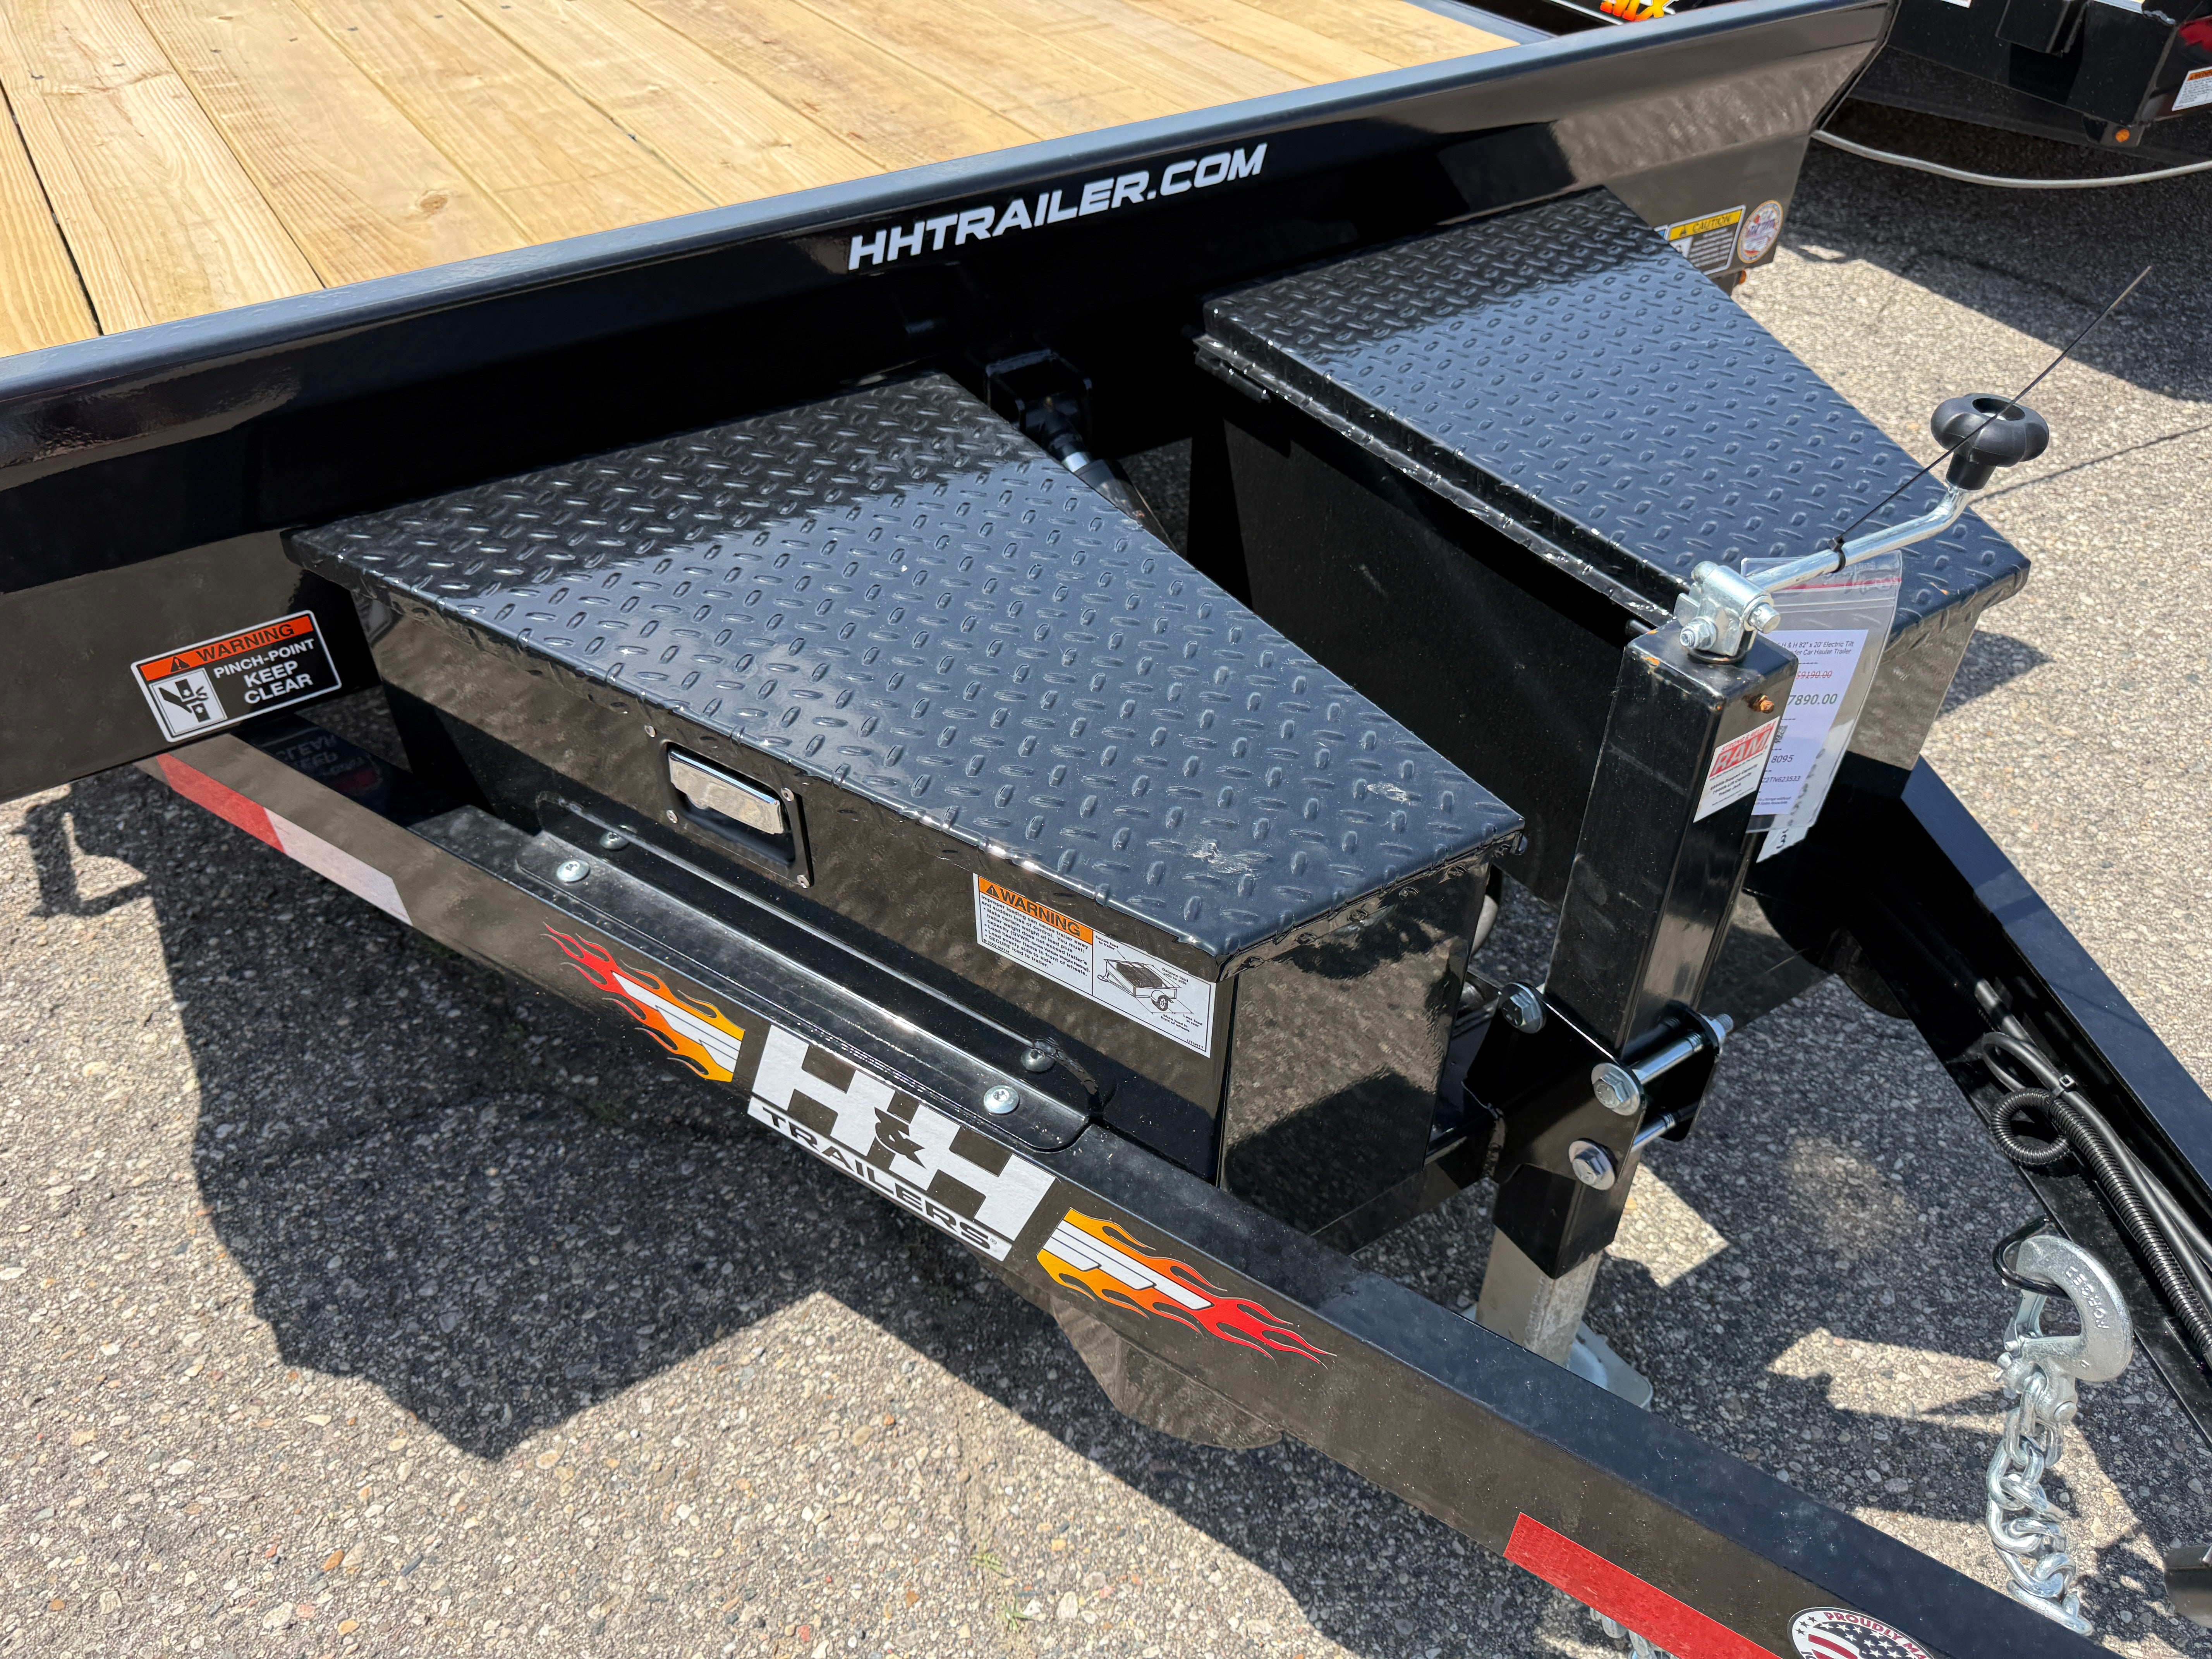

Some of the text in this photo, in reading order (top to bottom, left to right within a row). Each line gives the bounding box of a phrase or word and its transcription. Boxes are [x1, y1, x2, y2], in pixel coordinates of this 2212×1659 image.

[848, 143, 1268, 270] HHTRAILER.COM
[196, 624, 294, 661] WARNING
[213, 639, 314, 678] PINCH-POINT
[243, 661, 298, 687] KEEP
[244, 673, 313, 704] CLEAR
[1713, 730, 1771, 774] RAM
[981, 895, 1088, 950] Improper loading can cause trailer away
[987, 919, 1009, 933] capacity
[987, 908, 1000, 918] Make
[1002, 915, 1020, 927] certain
[1021, 924, 1039, 938] weight
[1048, 937, 1059, 946] load
[1061, 944, 1072, 953] plus
[993, 905, 1012, 918] sudden
[1013, 915, 1024, 924] loss
[1033, 925, 1054, 938] control.
[1057, 936, 1067, 945] You
[1069, 942, 1084, 953] must:
[1000, 888, 1080, 937] WARNING
[987, 913, 1002, 924] trailer
[1003, 921, 1020, 934] weight
[1022, 930, 1034, 940] does
[1046, 942, 1065, 955] exceed
[1066, 952, 1087, 965] trailer's
[988, 930, 1001, 939] Load
[1002, 937, 1019, 949] evenly
[1021, 946, 1032, 955] side
[1040, 955, 1053, 965] side.
[988, 924, 1001, 934] Load
[1002, 931, 1021, 944] heavier
[1023, 941, 1037, 952] items
[1045, 952, 1058, 962] front
[1066, 963, 1087, 976] wheels.
[989, 935, 1010, 949] SECURE
[1012, 946, 1023, 956] load
[1031, 956, 1048, 968] trailer.
[762, 1106, 991, 1250] TRAILERS
[1823, 1612, 1903, 1641] PROUDLY
